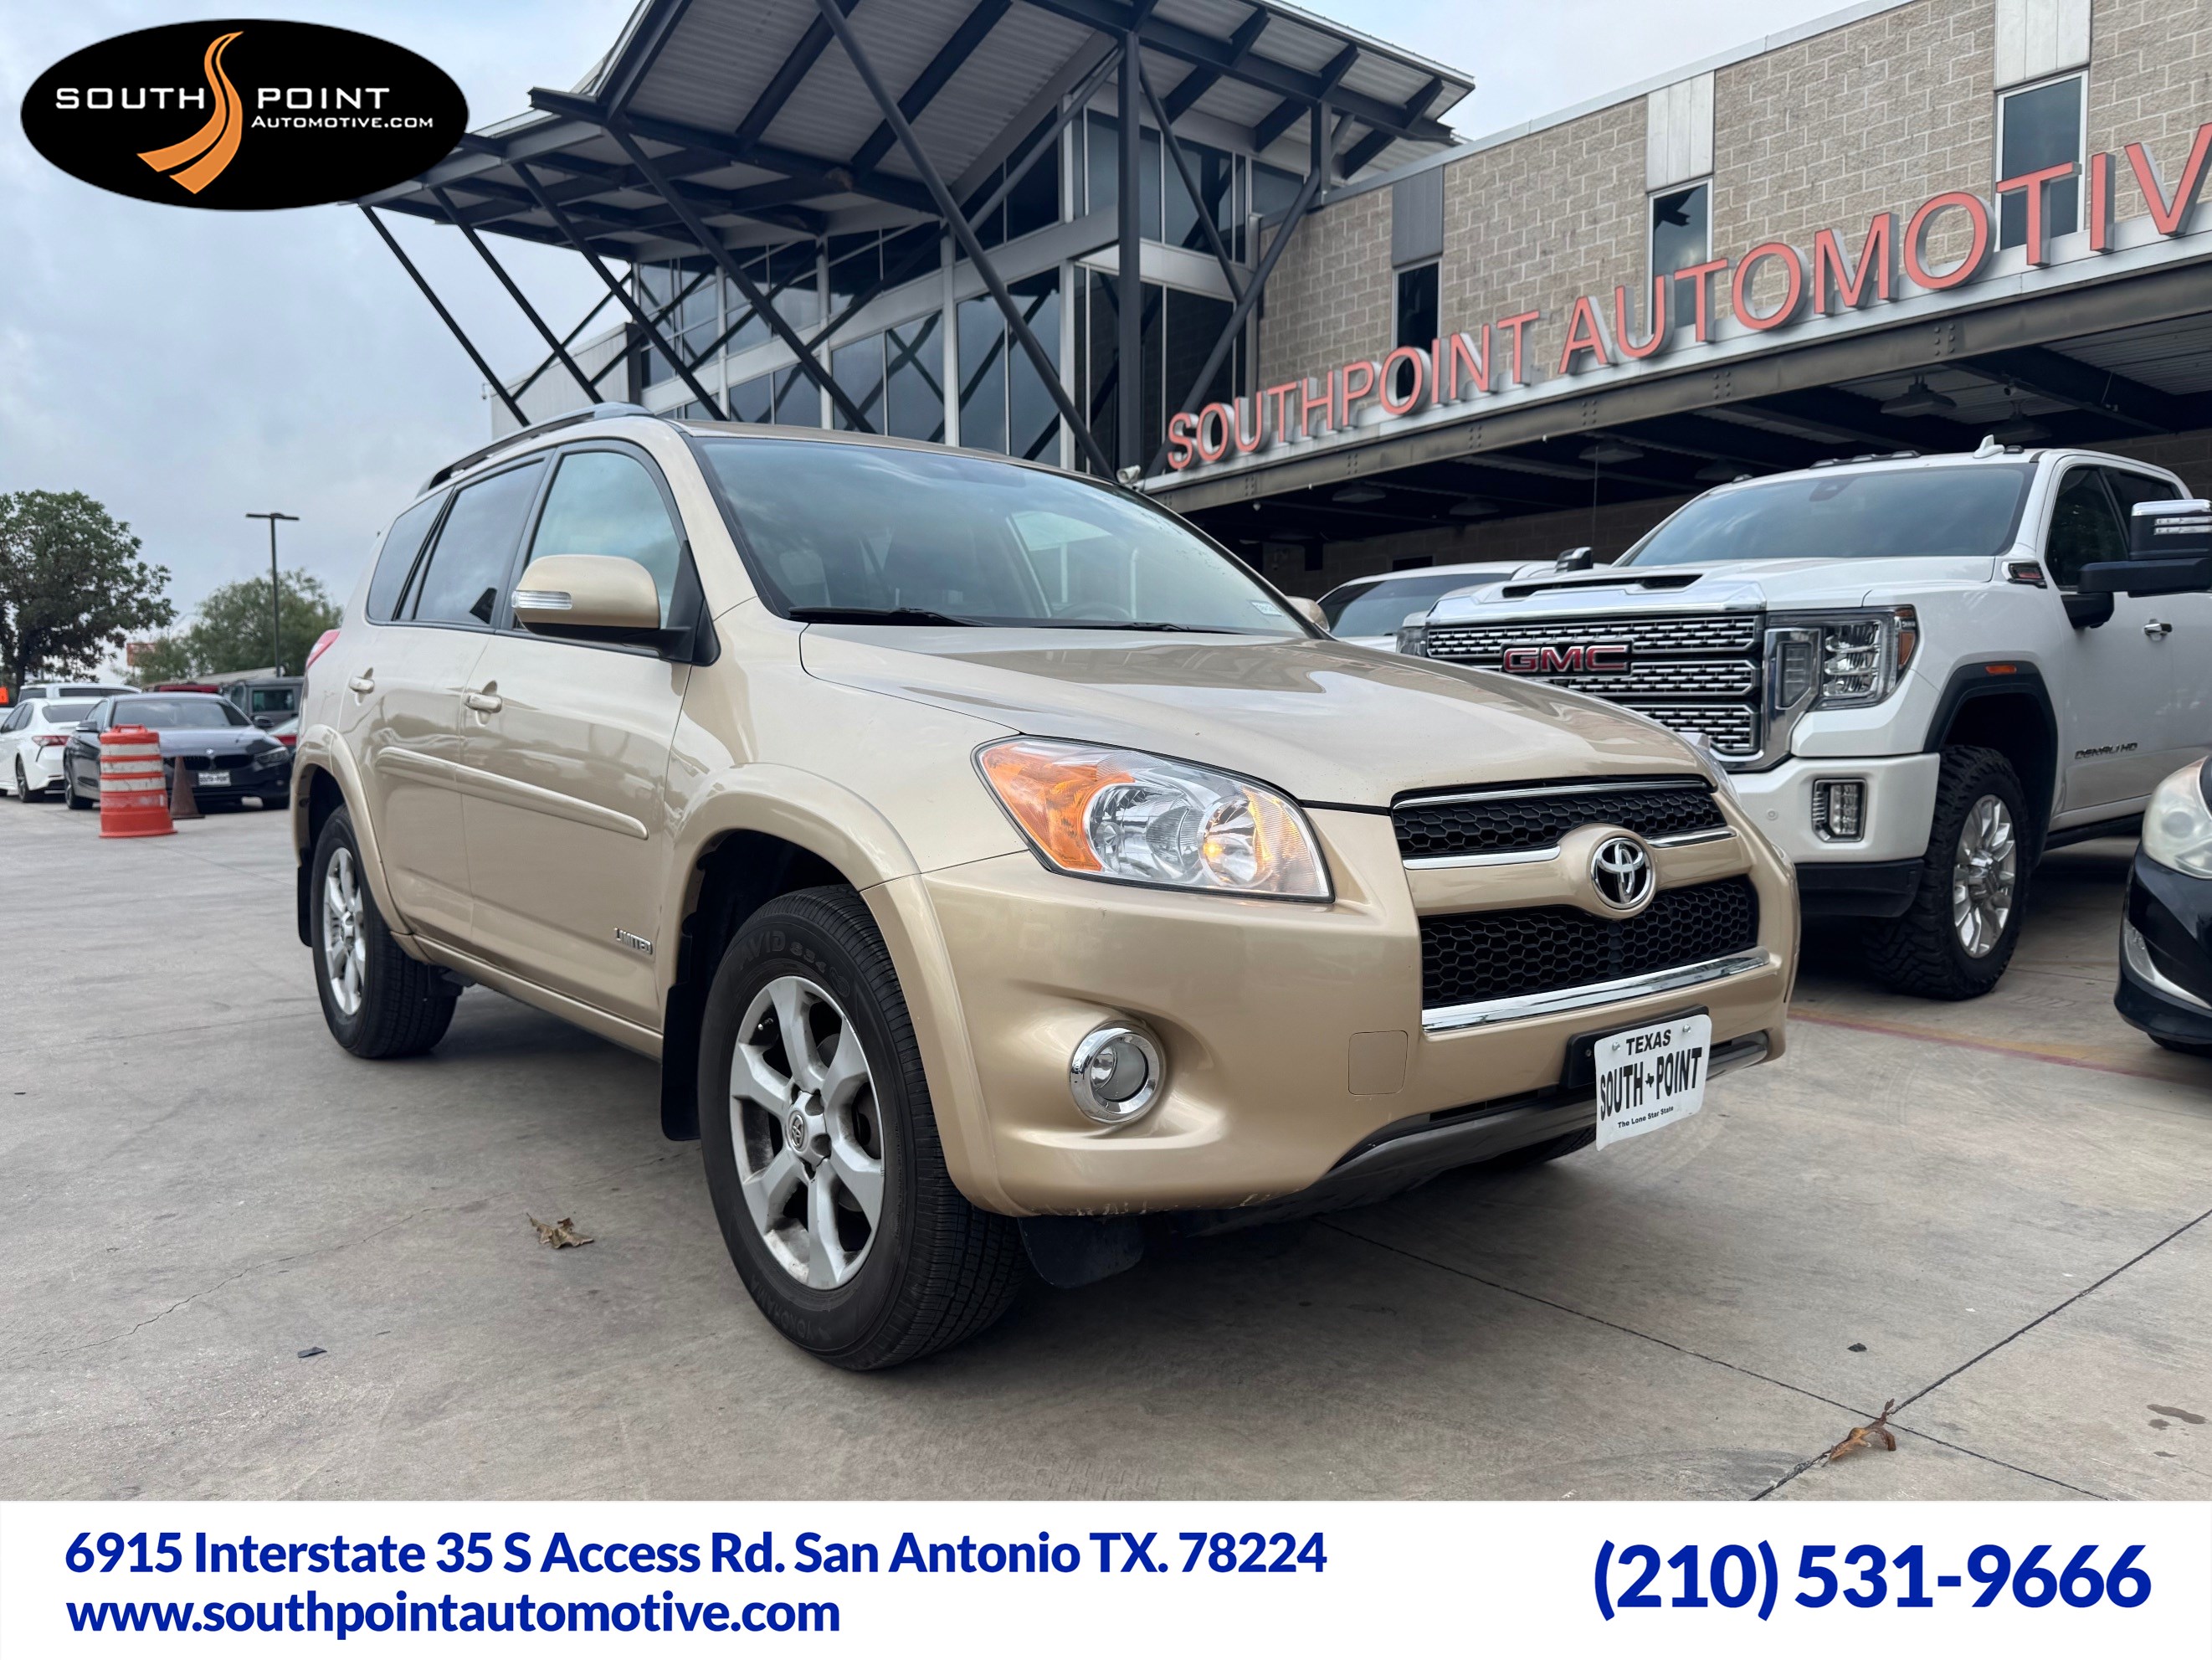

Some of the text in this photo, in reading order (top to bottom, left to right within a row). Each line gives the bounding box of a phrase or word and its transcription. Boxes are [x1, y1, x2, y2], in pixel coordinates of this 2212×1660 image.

[1167, 122, 2212, 470] SOUTHPOINT AUTOMOTIV
[1503, 644, 1626, 672] GMC
[1625, 1029, 1672, 1056] TEXAS
[1600, 1046, 1703, 1122] SOUTH POINT
[1618, 1105, 1674, 1128] The Lone Star State
